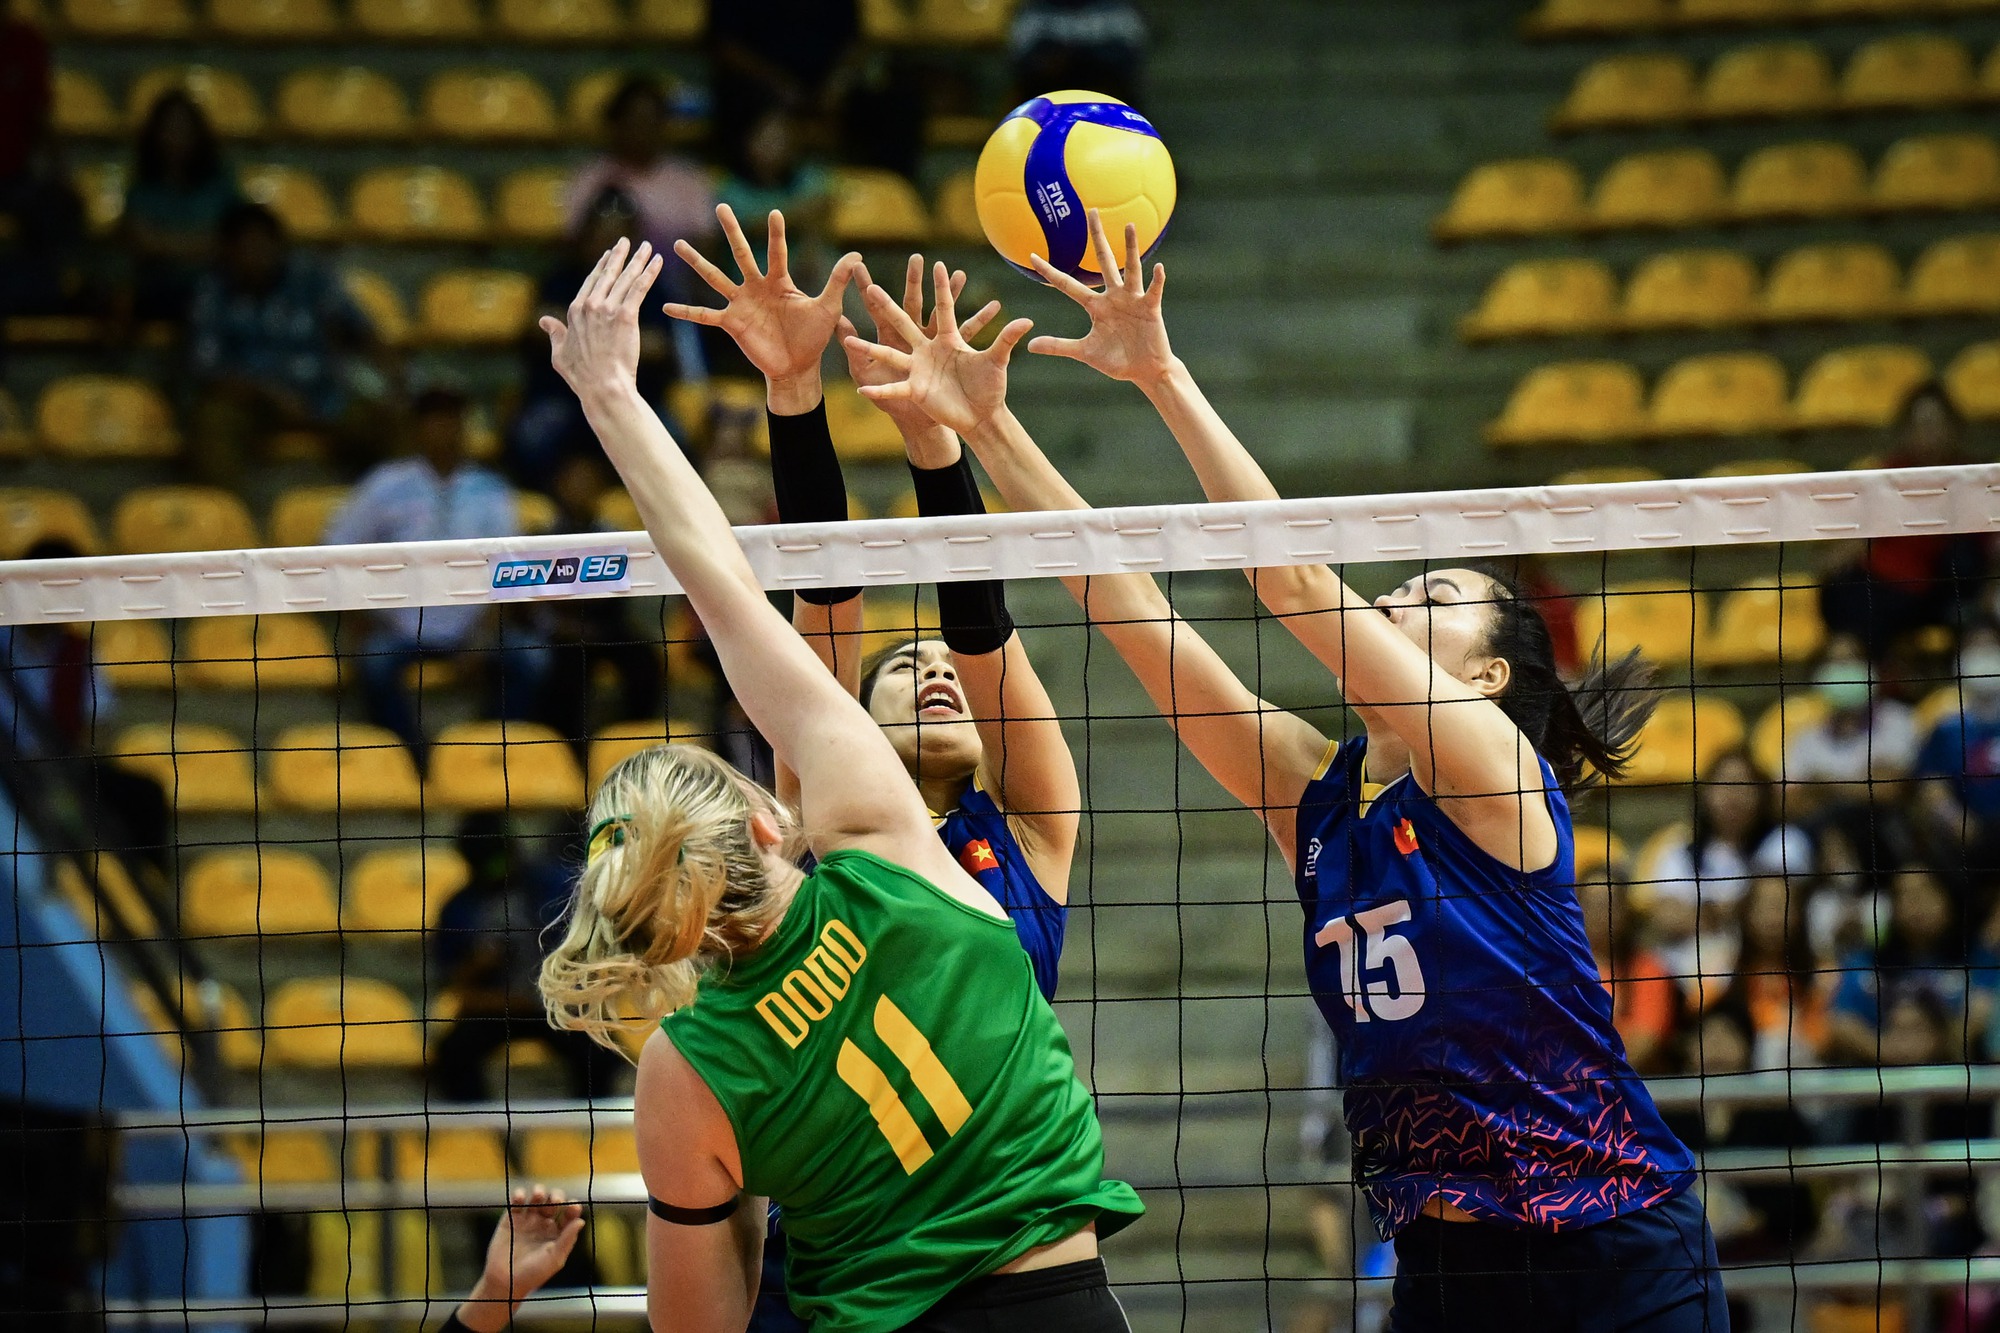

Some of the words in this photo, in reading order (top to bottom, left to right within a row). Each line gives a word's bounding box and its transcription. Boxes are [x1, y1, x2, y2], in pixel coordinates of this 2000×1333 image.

[1046, 181, 1071, 219] FIVB
[496, 560, 556, 583] PPTV
[556, 565, 575, 577] HD
[586, 556, 622, 577] 36
[754, 919, 867, 1050] DODD
[1314, 900, 1426, 1023] 15
[836, 993, 974, 1176] 11
